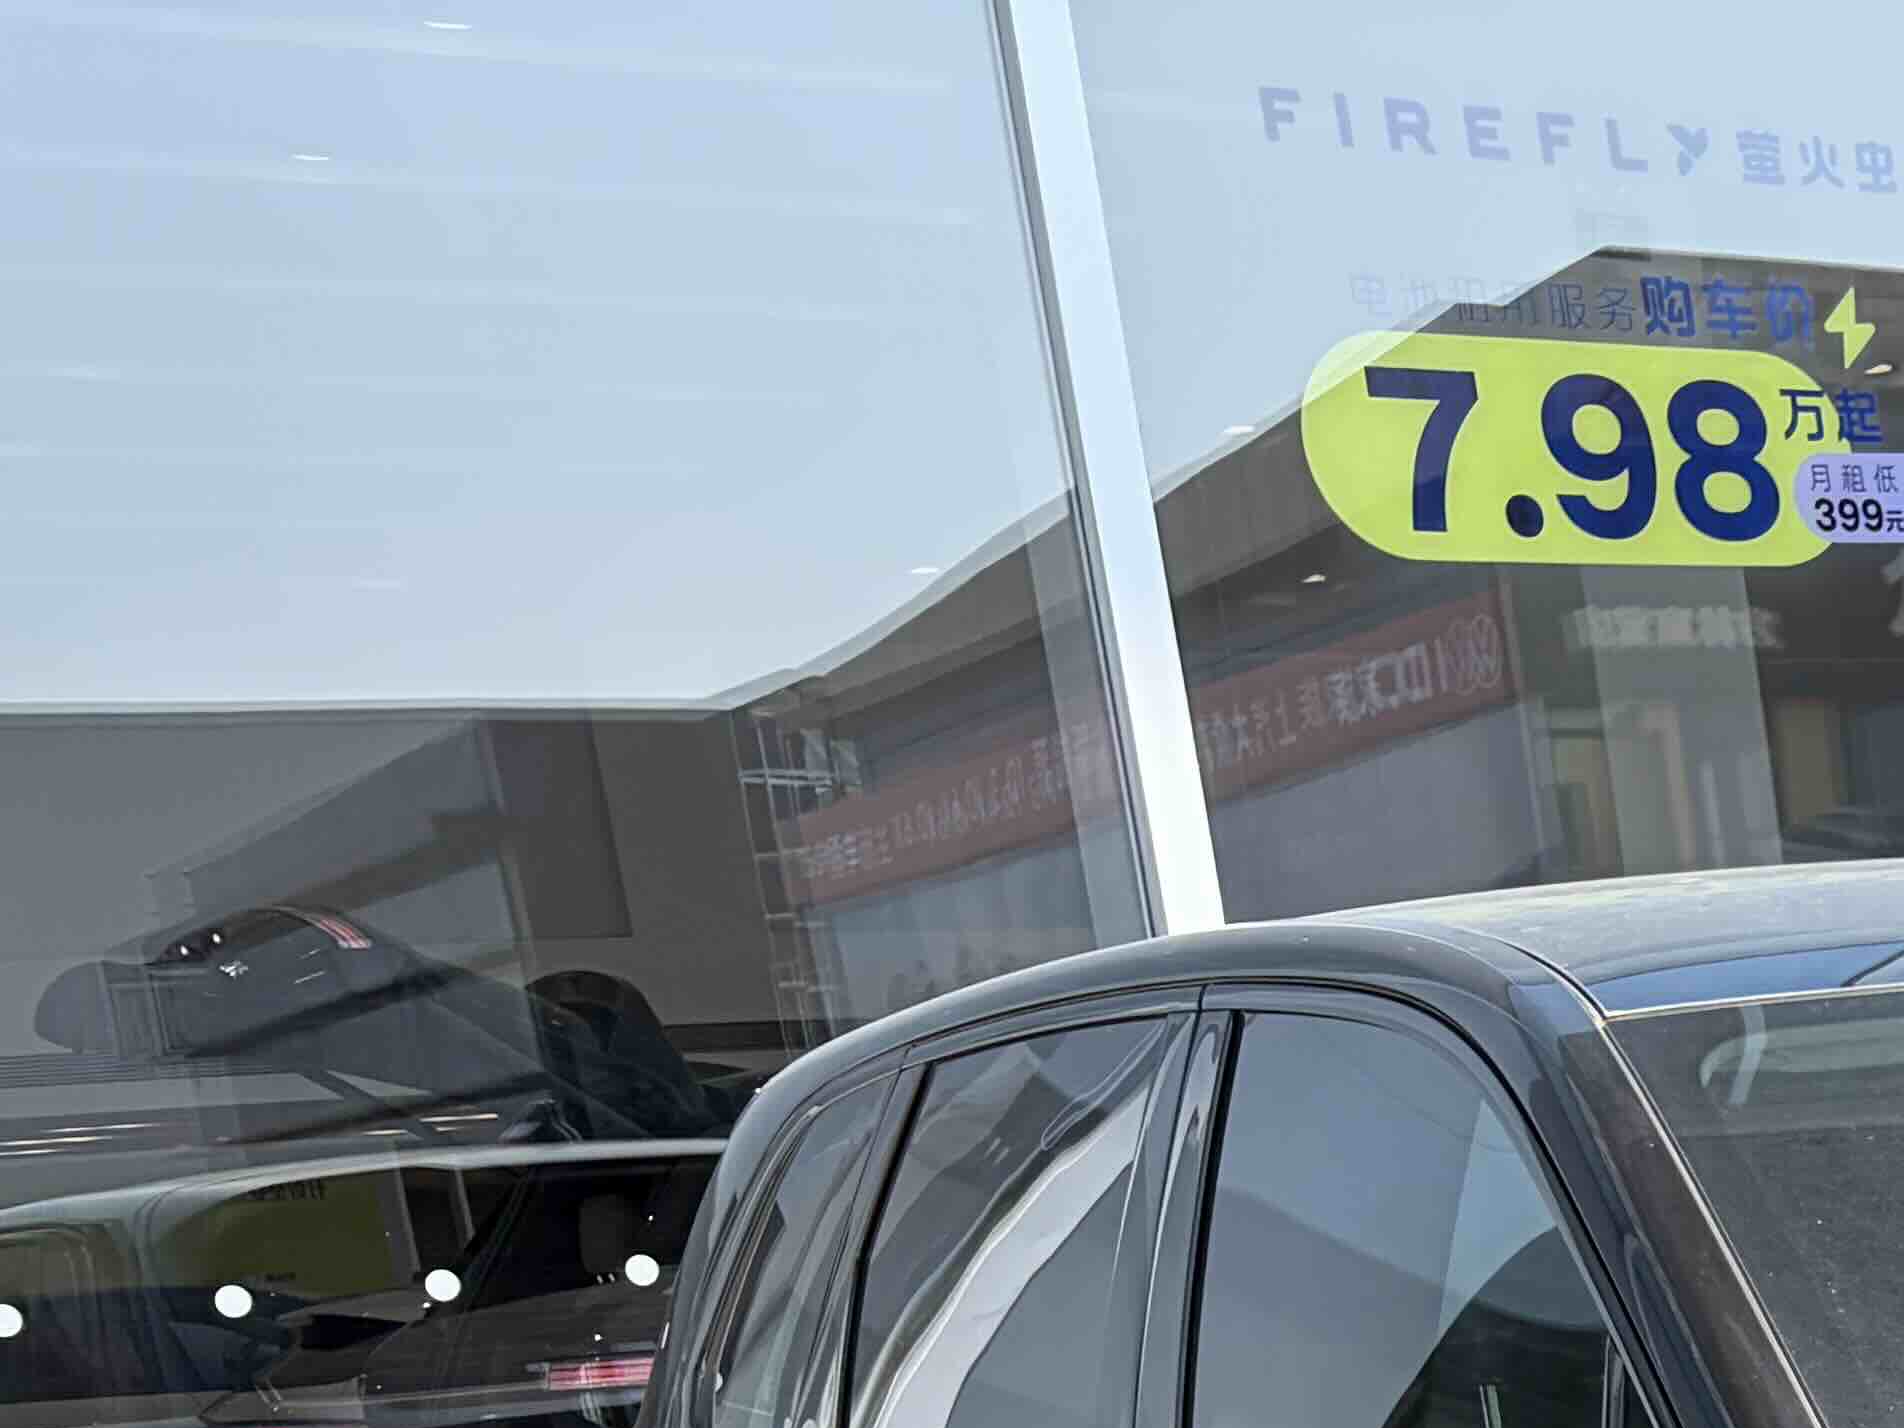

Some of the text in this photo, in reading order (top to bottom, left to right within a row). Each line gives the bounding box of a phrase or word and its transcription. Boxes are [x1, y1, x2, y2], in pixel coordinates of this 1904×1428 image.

[1736, 128, 1897, 193] 萤火虫
[1364, 365, 1884, 542] 7.98 万起
